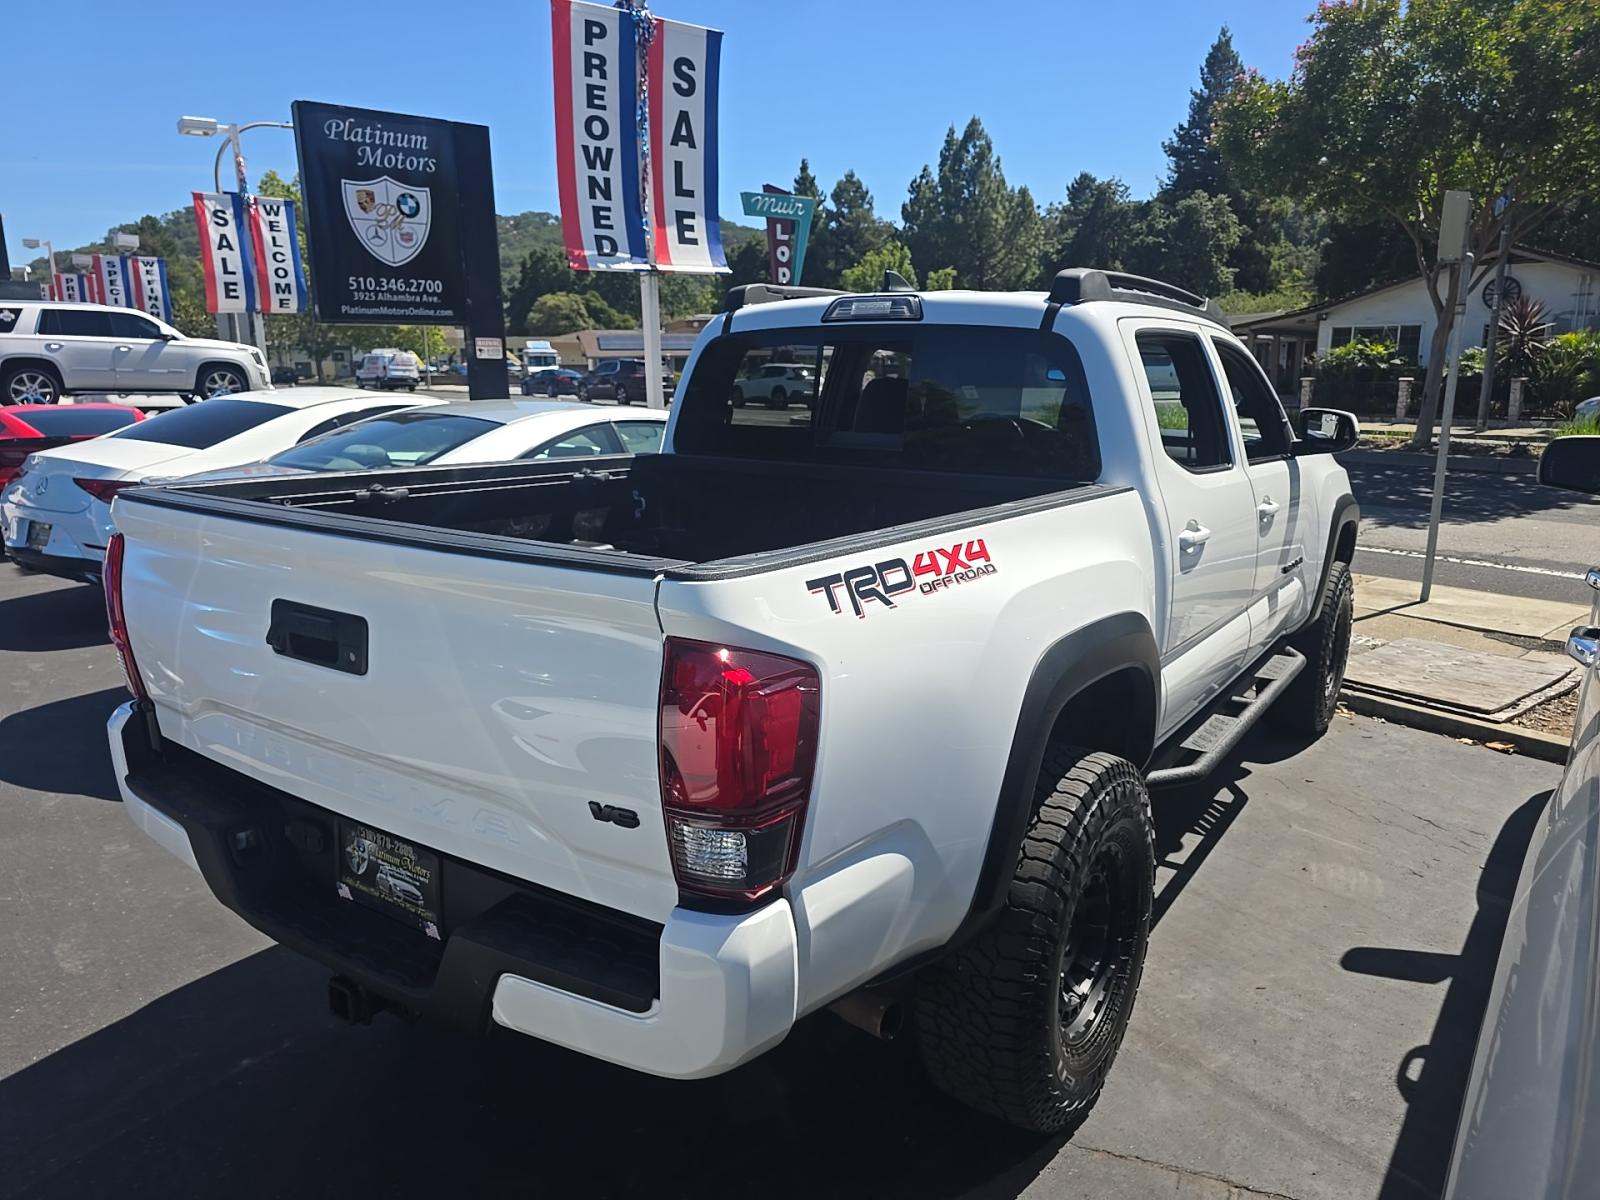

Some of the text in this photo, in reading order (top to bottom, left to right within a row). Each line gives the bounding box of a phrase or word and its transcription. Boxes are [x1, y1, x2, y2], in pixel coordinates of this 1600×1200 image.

[323, 118, 429, 150] Platinum
[581, 19, 618, 257] PREOWNED
[357, 146, 437, 172] Motors
[670, 57, 698, 245] SALE
[751, 195, 805, 216] Muir
[212, 209, 239, 299] SALE
[263, 204, 292, 308] WELCOME
[776, 223, 791, 284] LOD
[348, 277, 442, 292] 510.346.2700
[353, 292, 441, 303] 3925 Alhambra Ave.
[341, 305, 453, 316] PlatinumMotorsOnline.com
[805, 557, 917, 619] TRD
[919, 564, 998, 595] OFF ROAD
[588, 801, 640, 829] V6
